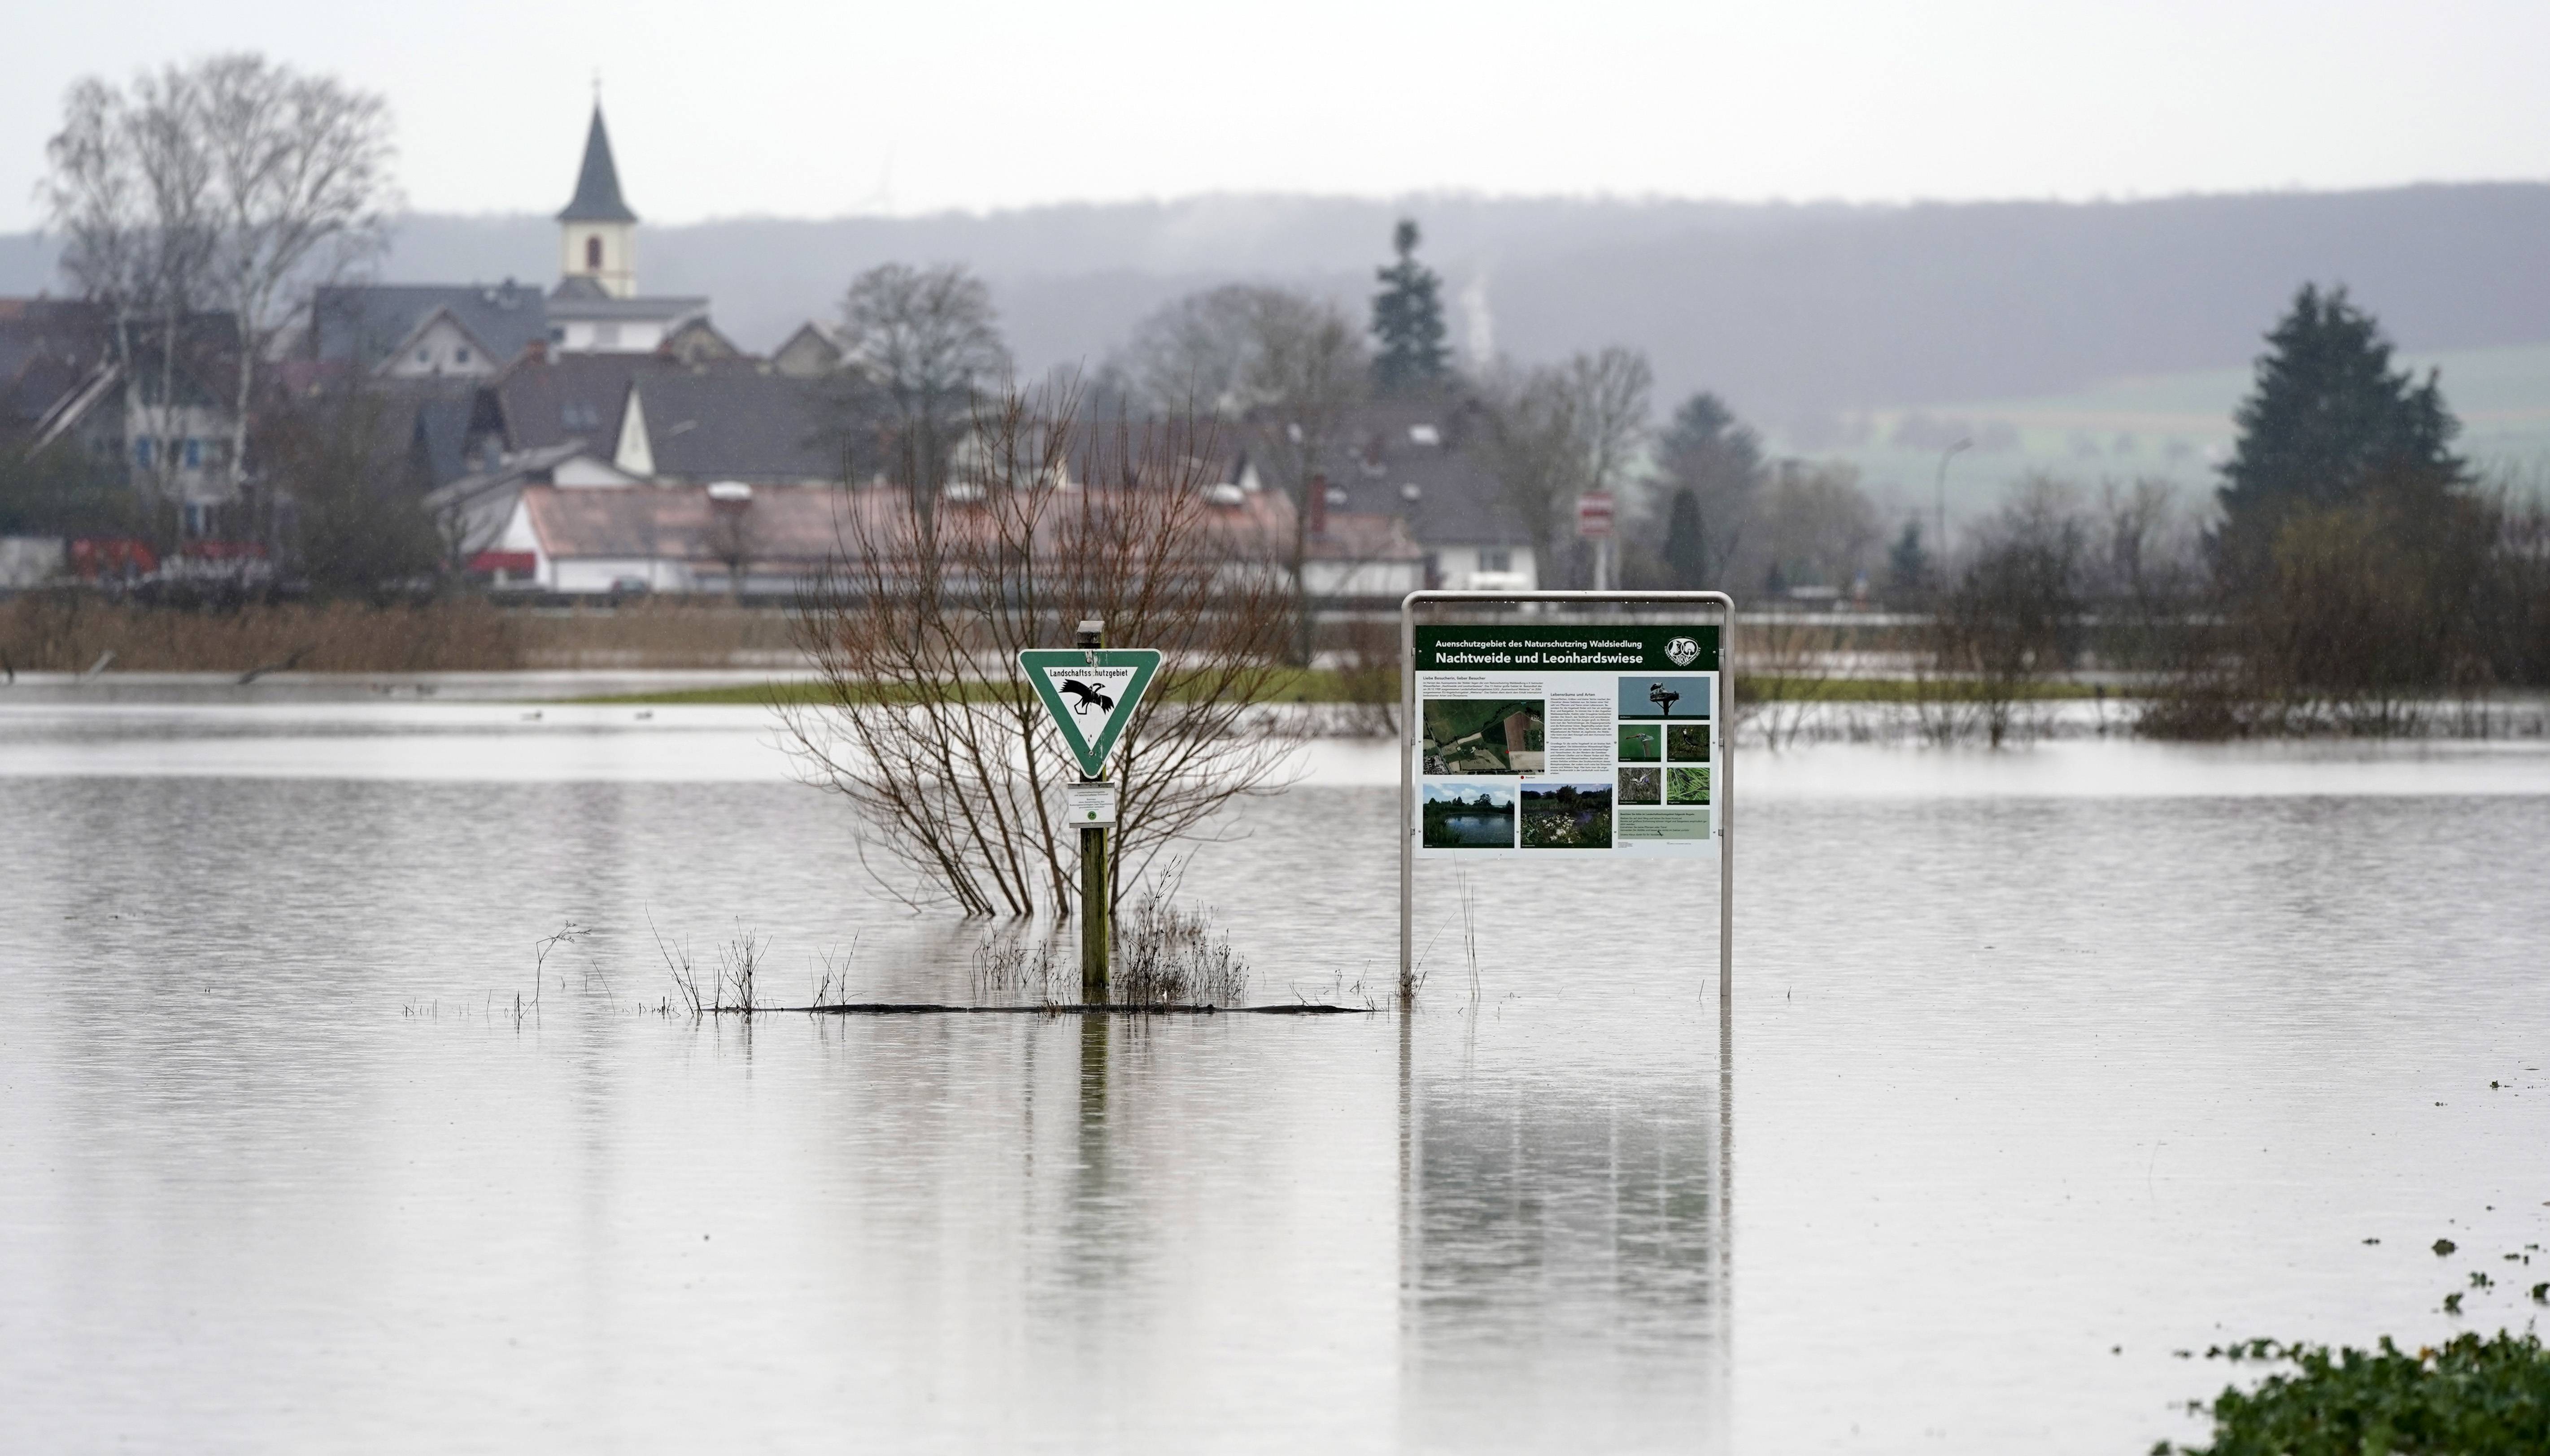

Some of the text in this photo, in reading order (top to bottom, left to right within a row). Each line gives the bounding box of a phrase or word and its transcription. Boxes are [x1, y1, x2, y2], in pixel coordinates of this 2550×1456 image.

[1435, 640, 1507, 649] Auenschutzgebiet
[1525, 640, 1587, 649] Naturschutzring
[1589, 640, 1642, 649] Waldsiedlung
[1436, 652, 1643, 663] Nachtweide und Leonhardswiese
[1676, 655, 1690, 664] NRW
[1050, 669, 1128, 678] Landschaftsshutzgebiet
